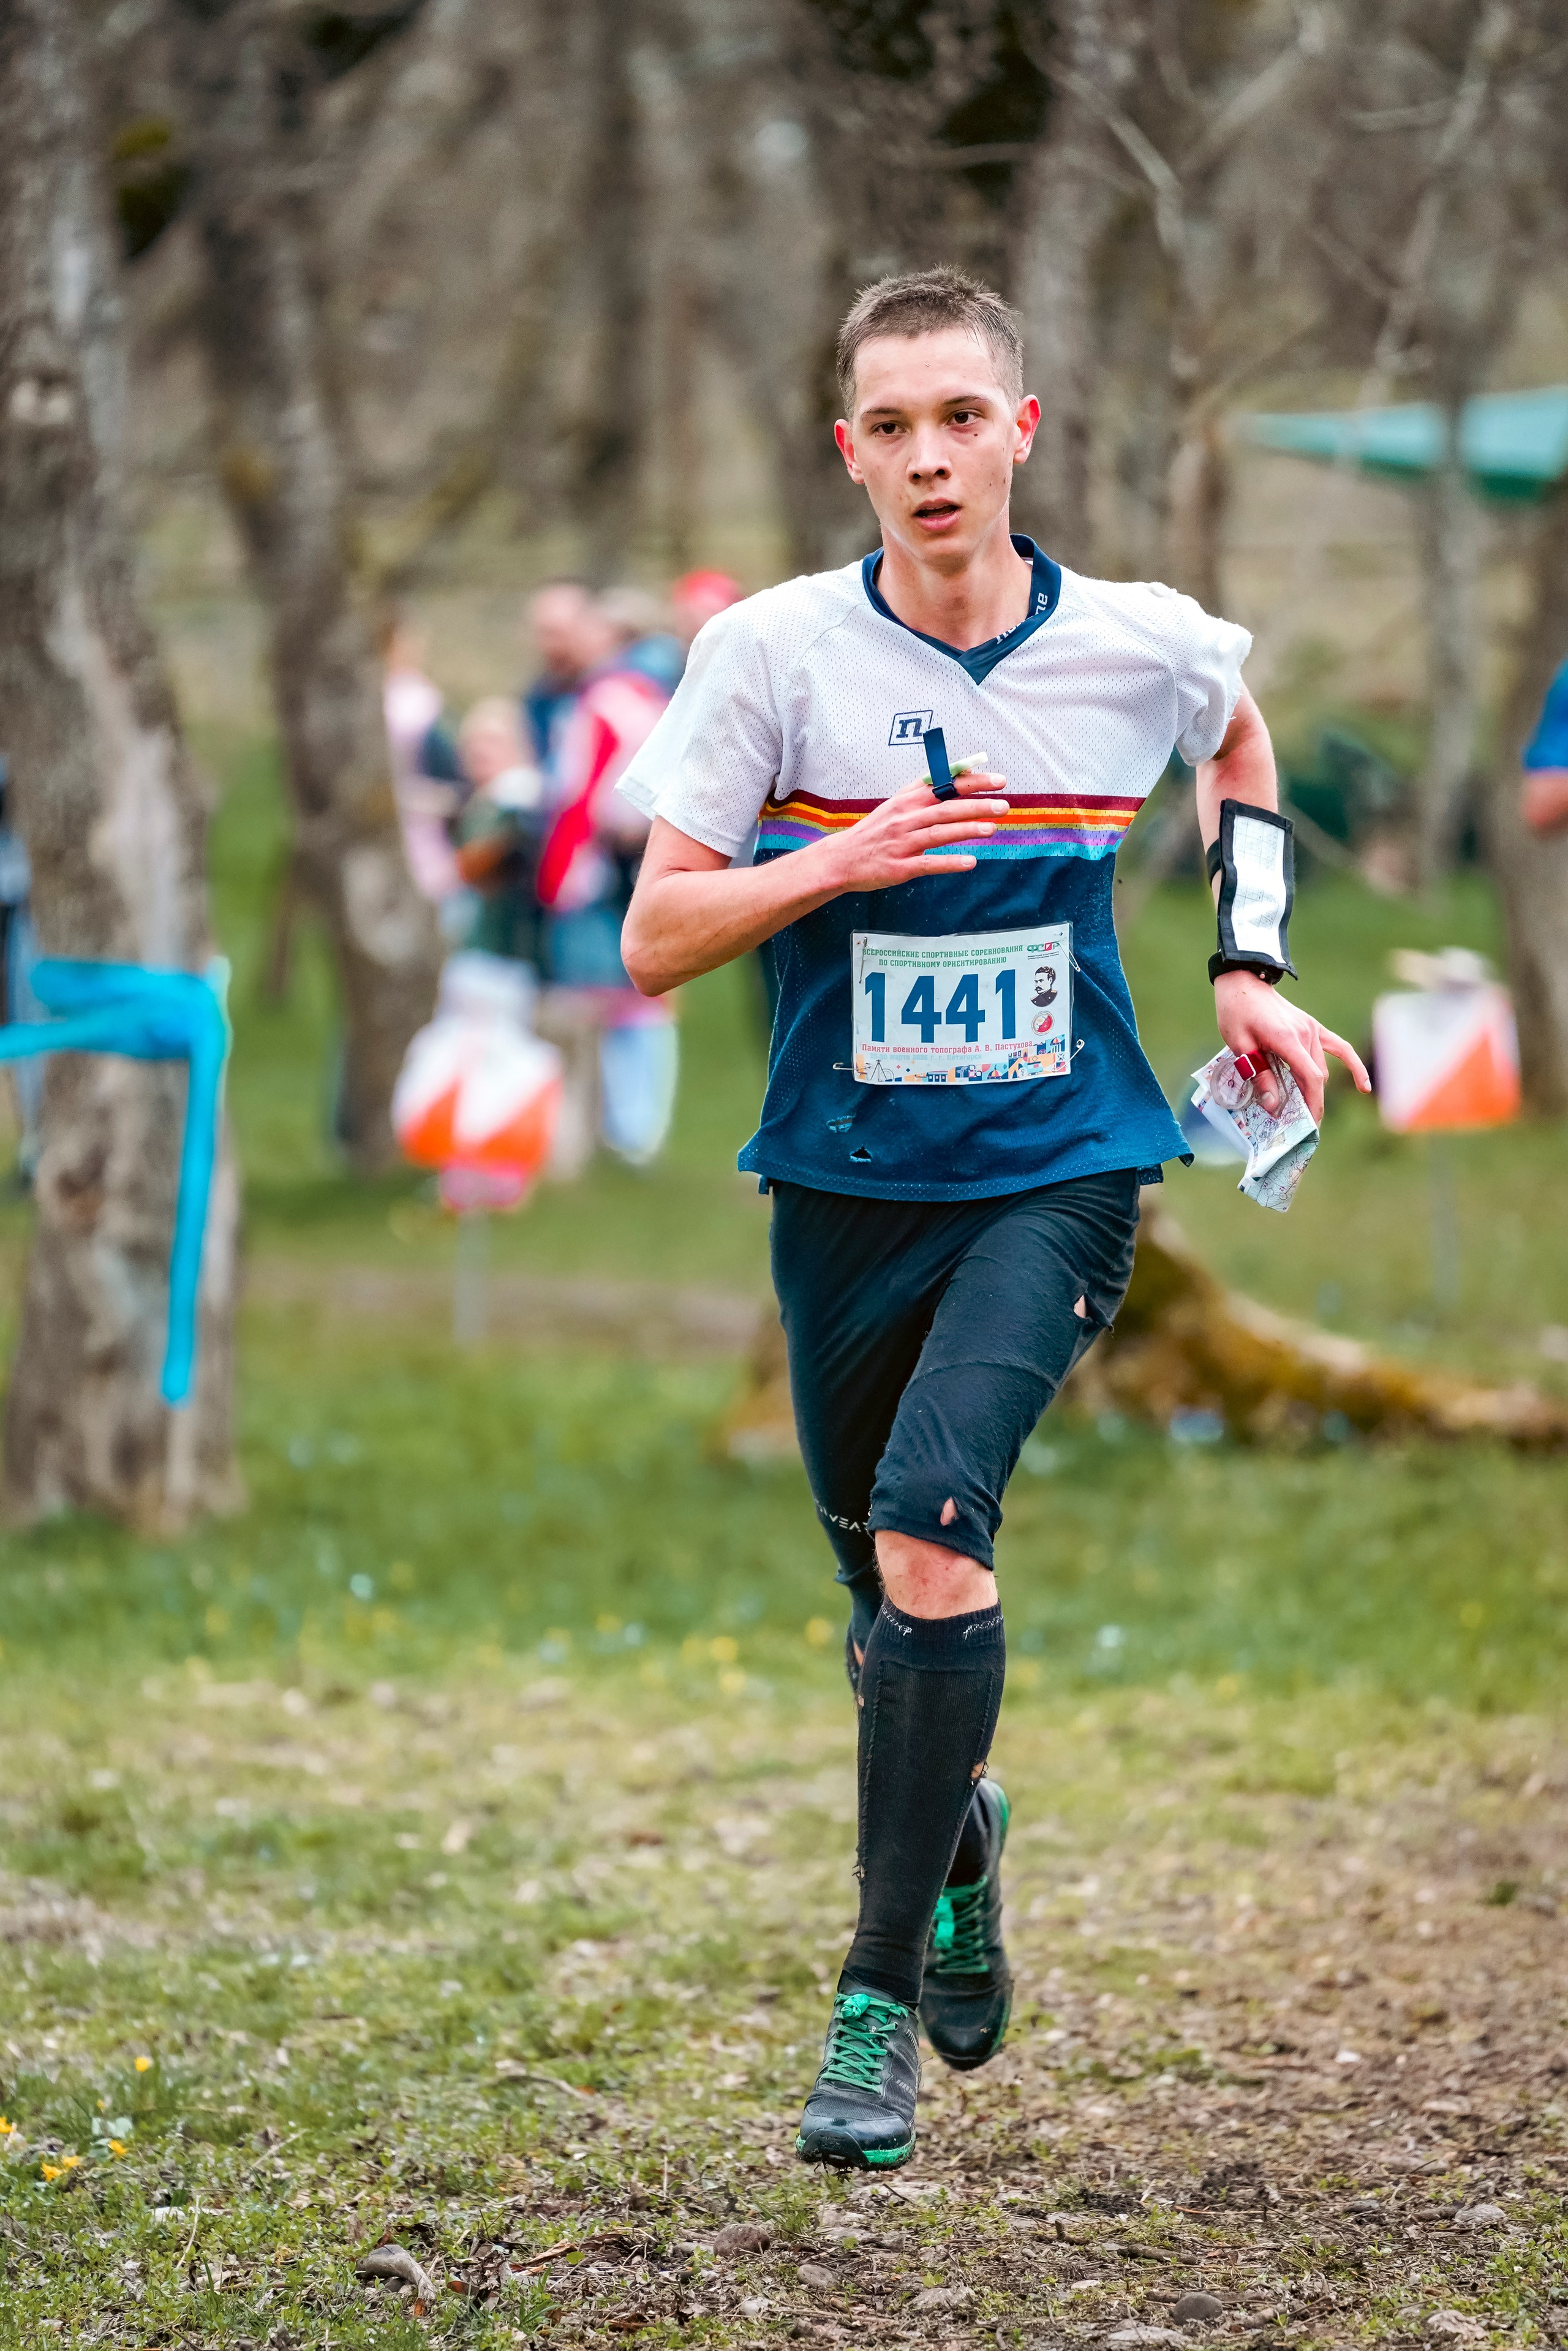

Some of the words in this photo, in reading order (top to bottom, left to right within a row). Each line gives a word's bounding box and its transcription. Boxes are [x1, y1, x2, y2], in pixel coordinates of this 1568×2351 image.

[862, 948, 919, 958] ВСЕРОССИЙСКИЕ
[922, 949, 969, 958] СПОРТИВНЫЕ
[971, 945, 1023, 956] СОРЕВНОВАНИЯ
[890, 959, 940, 968] СПОРТИВНОМУ
[943, 957, 1006, 967] ОРИЕНТИРОВАНИЮ
[865, 969, 1016, 1044] 1441
[862, 1044, 890, 1052] Памяти
[930, 1046, 972, 1055] топографа
[995, 1040, 1033, 1051] Пастухова
